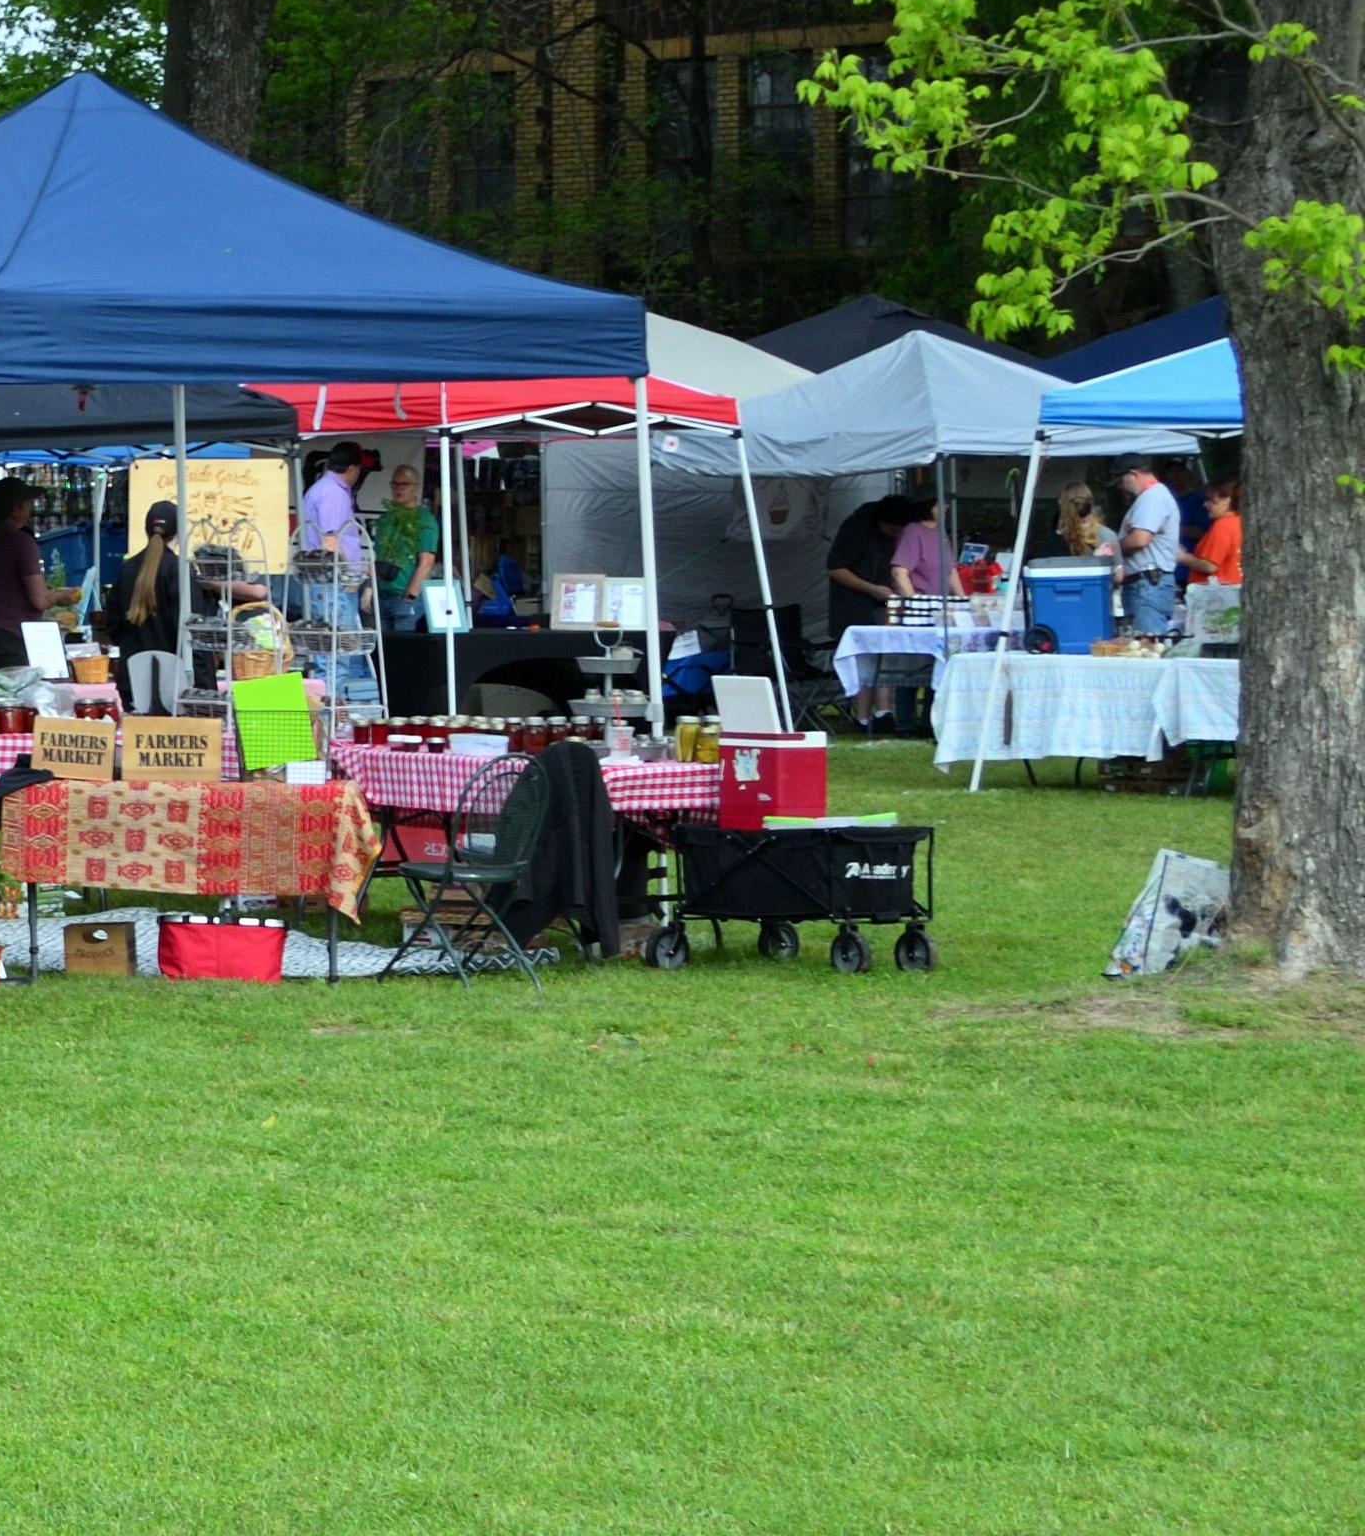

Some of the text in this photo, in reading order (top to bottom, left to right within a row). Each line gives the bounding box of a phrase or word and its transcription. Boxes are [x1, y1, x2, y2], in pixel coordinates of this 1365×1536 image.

[40, 732, 108, 750] FARMERS
[135, 734, 208, 750] FARMERS
[42, 748, 106, 766] MARKET
[139, 752, 205, 767] MARKET
